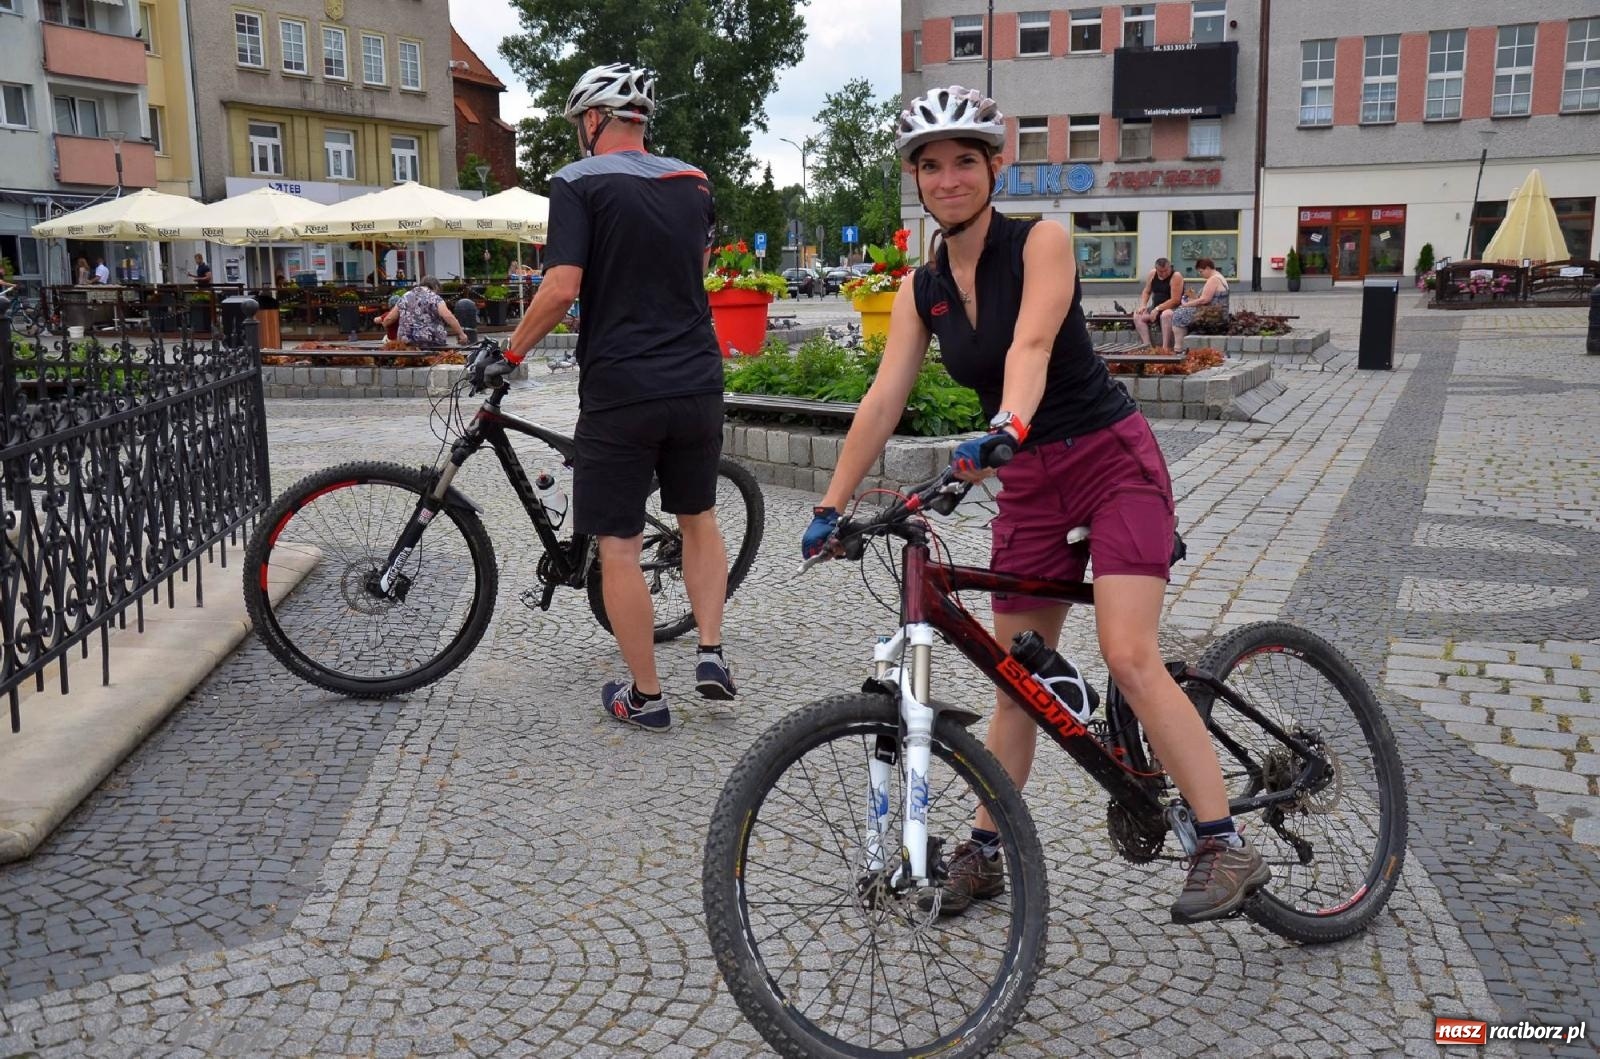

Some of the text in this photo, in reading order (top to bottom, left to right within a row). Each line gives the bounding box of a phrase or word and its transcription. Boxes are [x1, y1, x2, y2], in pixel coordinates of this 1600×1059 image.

[284, 184, 301, 194] TEB
[304, 224, 329, 234] Kozel
[351, 220, 375, 232] Kozel
[158, 228, 180, 237] Kozel
[202, 227, 224, 237] Kozel
[246, 228, 269, 238] Kozel
[757, 234, 765, 245] P
[1003, 658, 1084, 736] SCOTT
[909, 767, 929, 825] FOX
